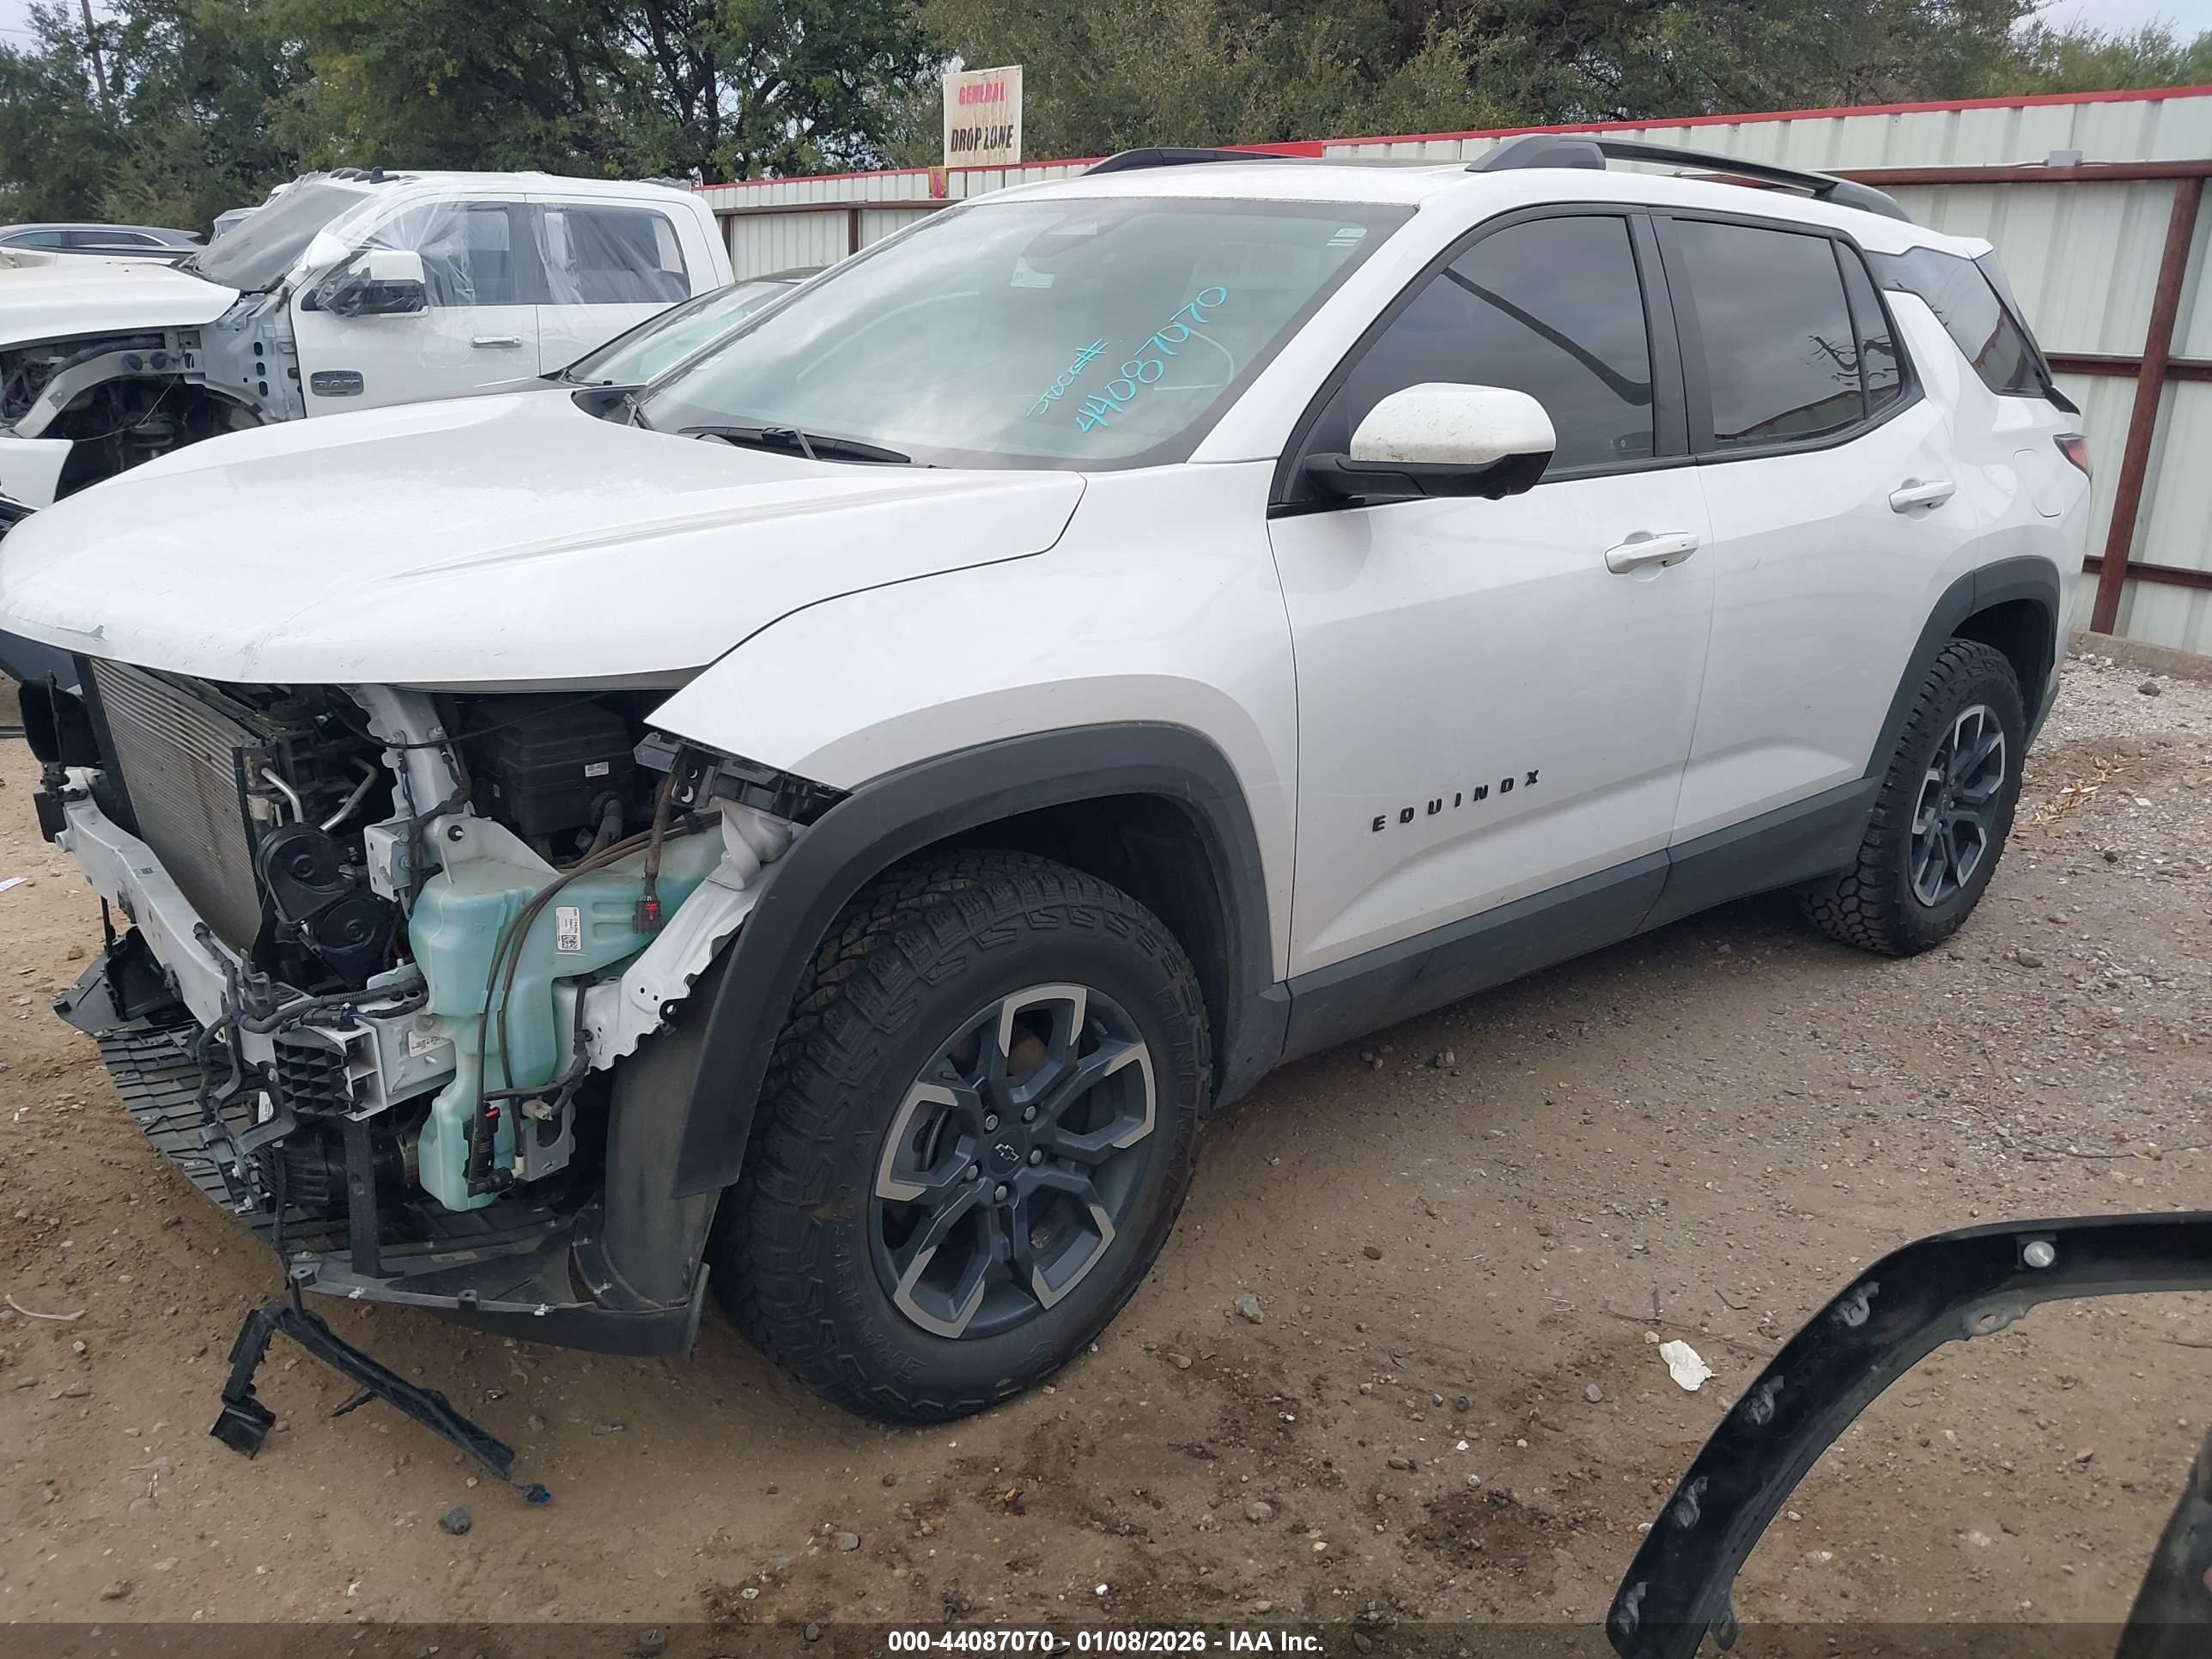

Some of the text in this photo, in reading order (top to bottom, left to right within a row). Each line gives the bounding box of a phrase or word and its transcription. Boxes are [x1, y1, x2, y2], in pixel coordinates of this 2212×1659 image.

[958, 82, 1006, 106] GENERAL
[950, 123, 1014, 153] DROP ZONE
[1075, 286, 1228, 434] 44087070
[1371, 769, 1540, 832] EQUINOX
